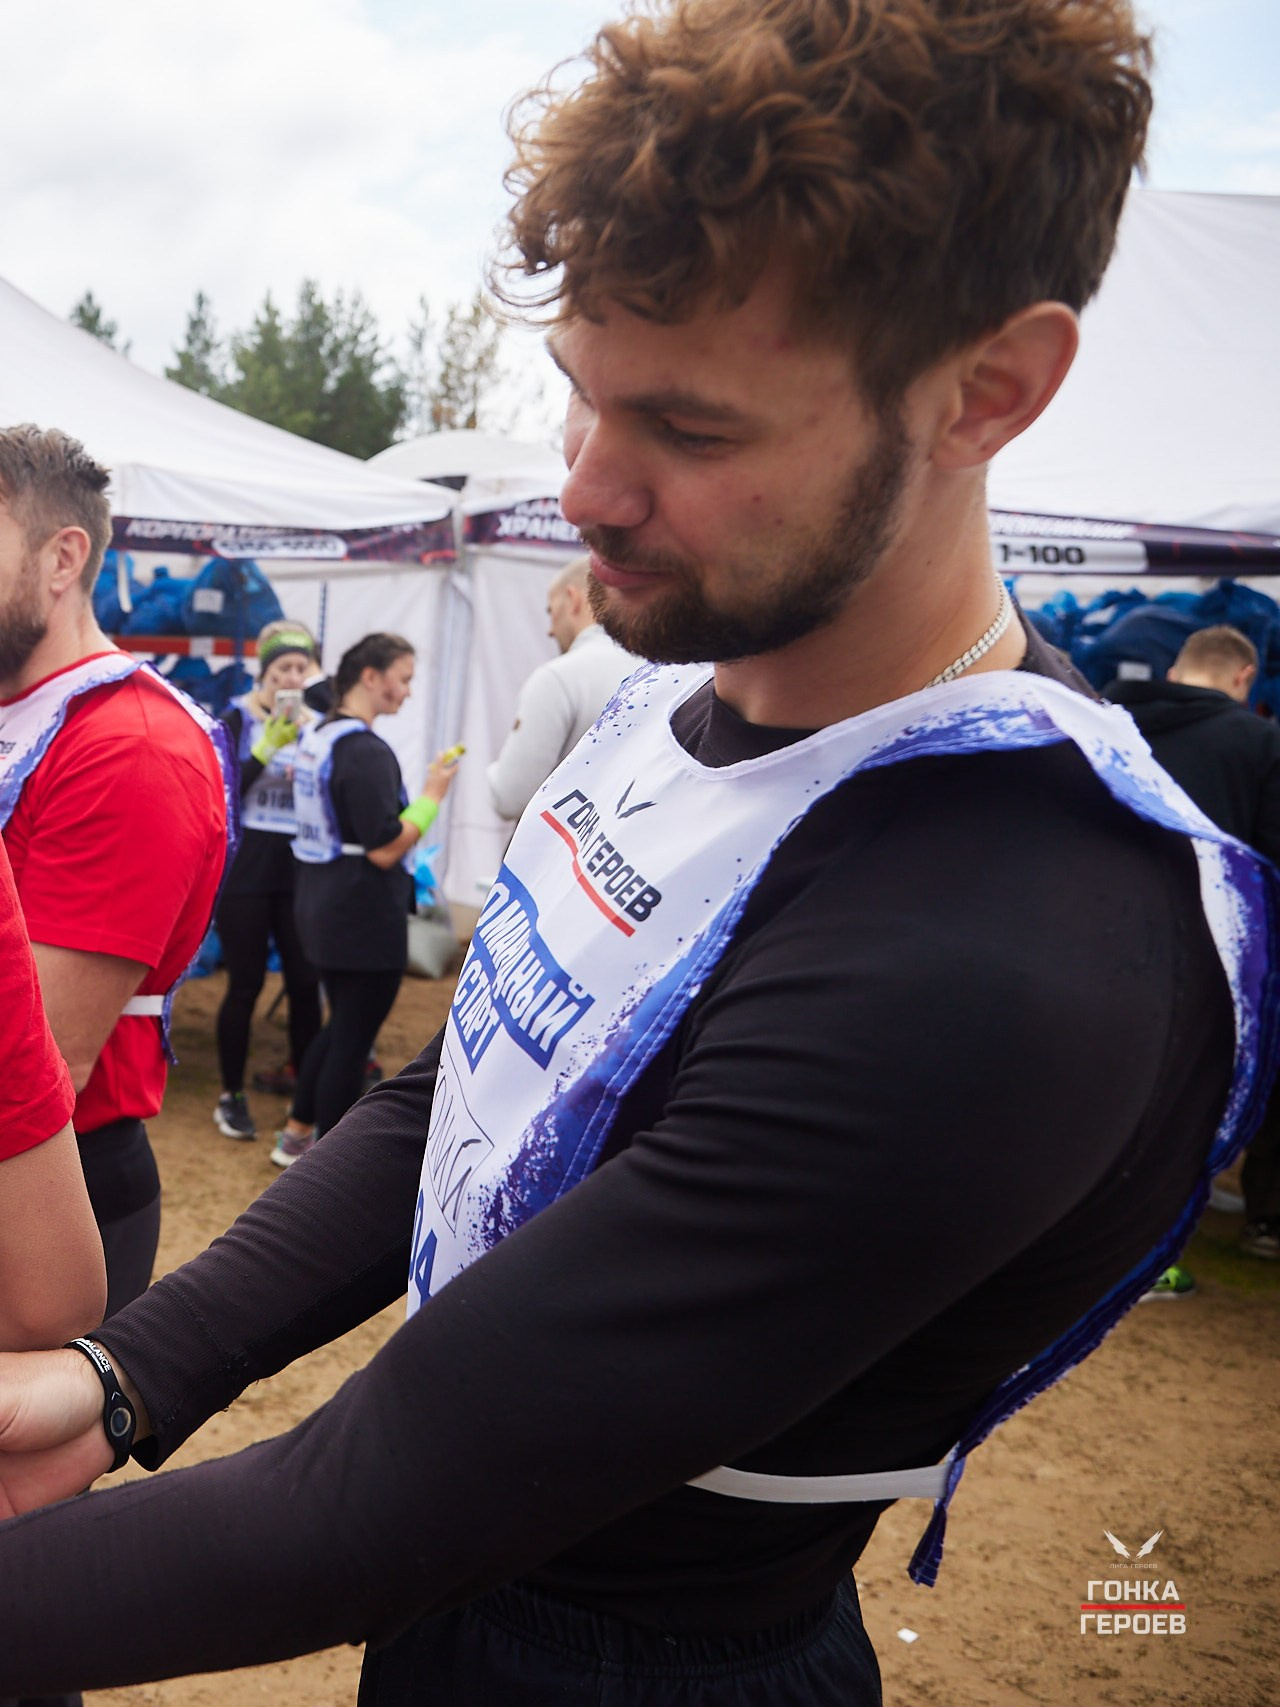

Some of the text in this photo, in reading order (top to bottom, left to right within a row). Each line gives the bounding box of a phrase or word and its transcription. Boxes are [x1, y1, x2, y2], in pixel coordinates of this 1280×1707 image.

[582, 831, 662, 923] ГЕРОЕВ
[454, 959, 501, 1060] СТАРТ
[476, 881, 589, 1053] ОМАНДНЫЙ
